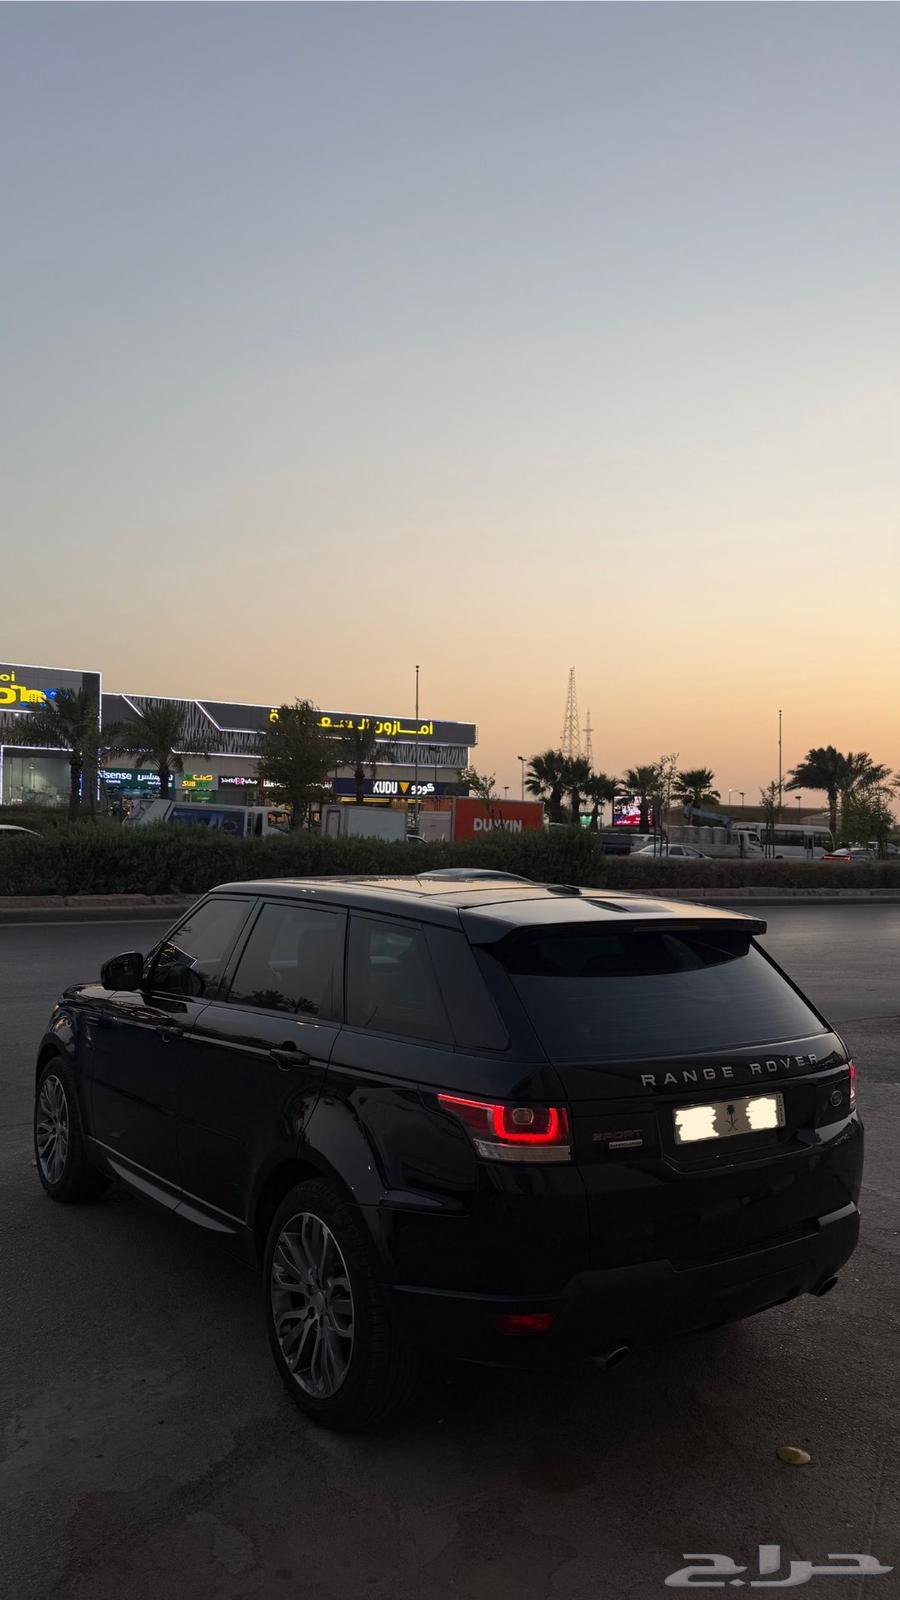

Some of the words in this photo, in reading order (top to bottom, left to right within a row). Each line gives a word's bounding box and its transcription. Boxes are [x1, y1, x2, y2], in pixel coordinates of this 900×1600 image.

[375, 720, 434, 735] أمازون
[373, 780, 398, 794] KUDU
[410, 783, 435, 795] كودو
[641, 1065, 735, 1087] RANGE
[749, 1054, 818, 1075] ROVER
[592, 1128, 644, 1142] SPORT
